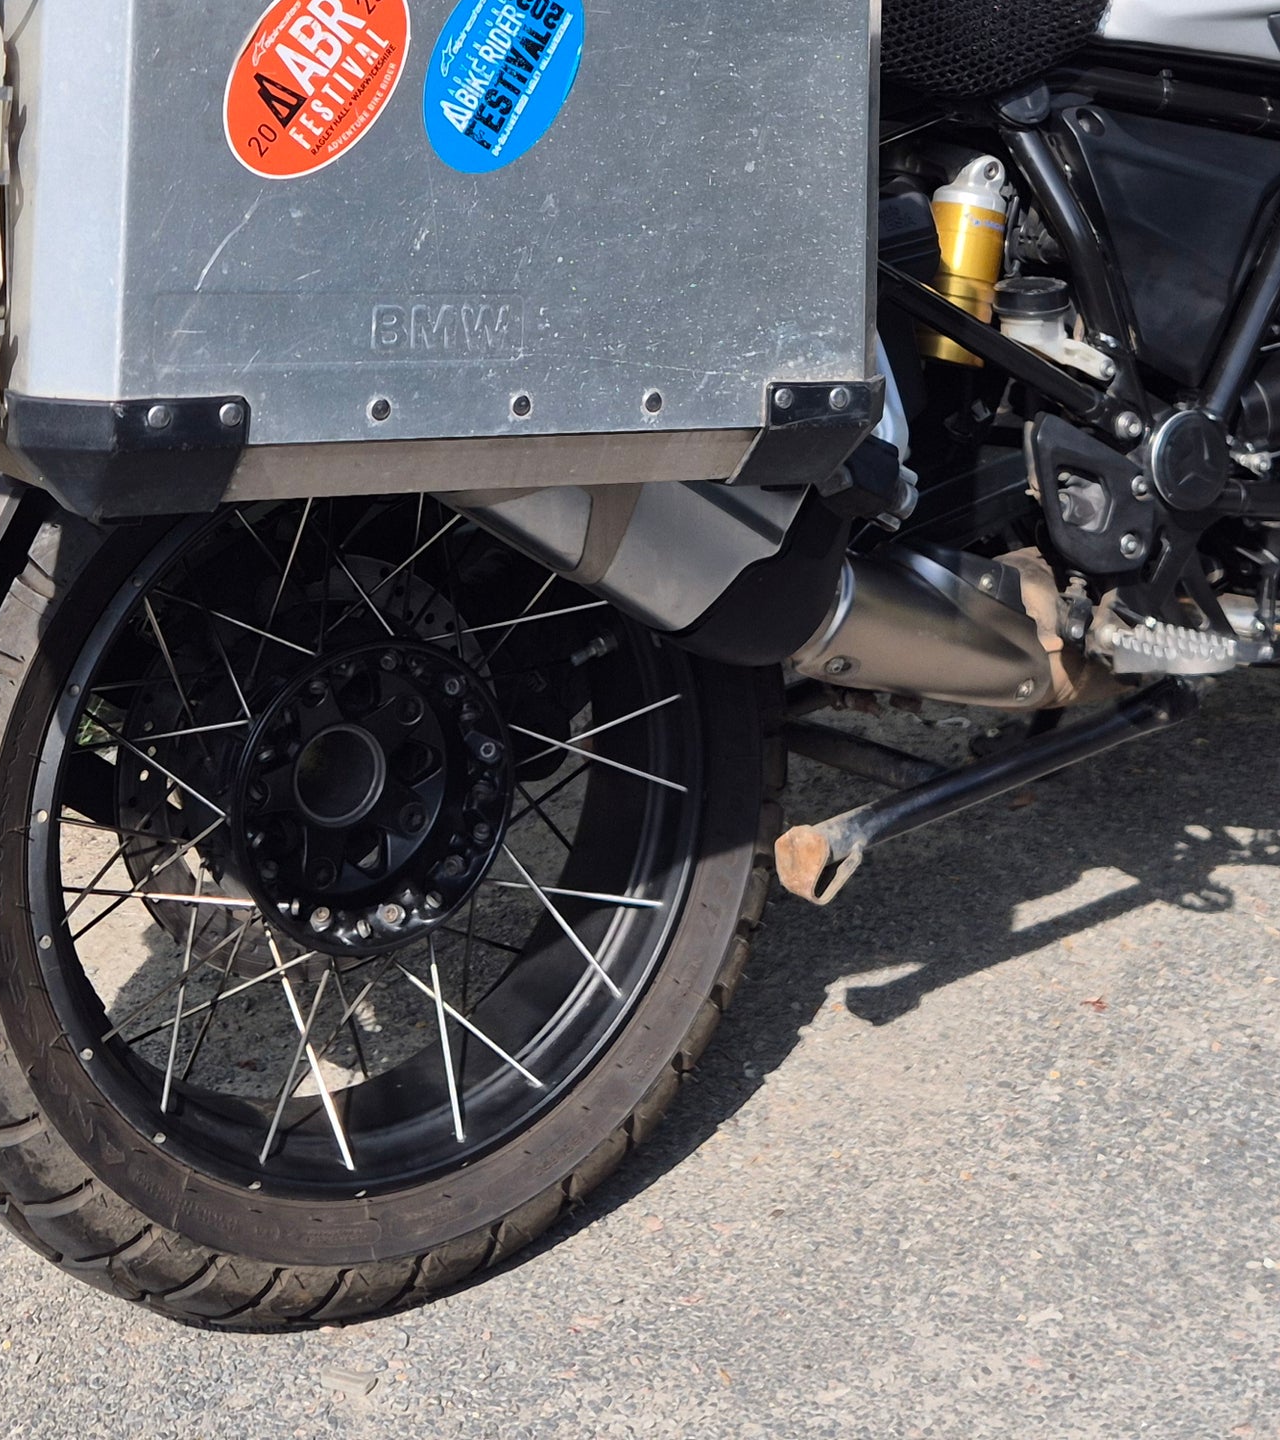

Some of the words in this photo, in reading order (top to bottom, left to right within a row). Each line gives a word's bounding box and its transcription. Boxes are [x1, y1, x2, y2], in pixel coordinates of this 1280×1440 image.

[287, 27, 389, 151] FESTIVAL
[310, 123, 334, 155] RAGLEY
[332, 106, 350, 127] HALL
[350, 43, 396, 101] WARWICKSHIRE
[454, 57, 496, 111] BIKE
[477, 2, 526, 68] RIDER
[463, 22, 552, 150] FESTIVAL
[247, 122, 278, 157] 20
[327, 110, 370, 153] ADVENTURE
[366, 90, 383, 111] BIKE
[371, 303, 510, 351] BMW
